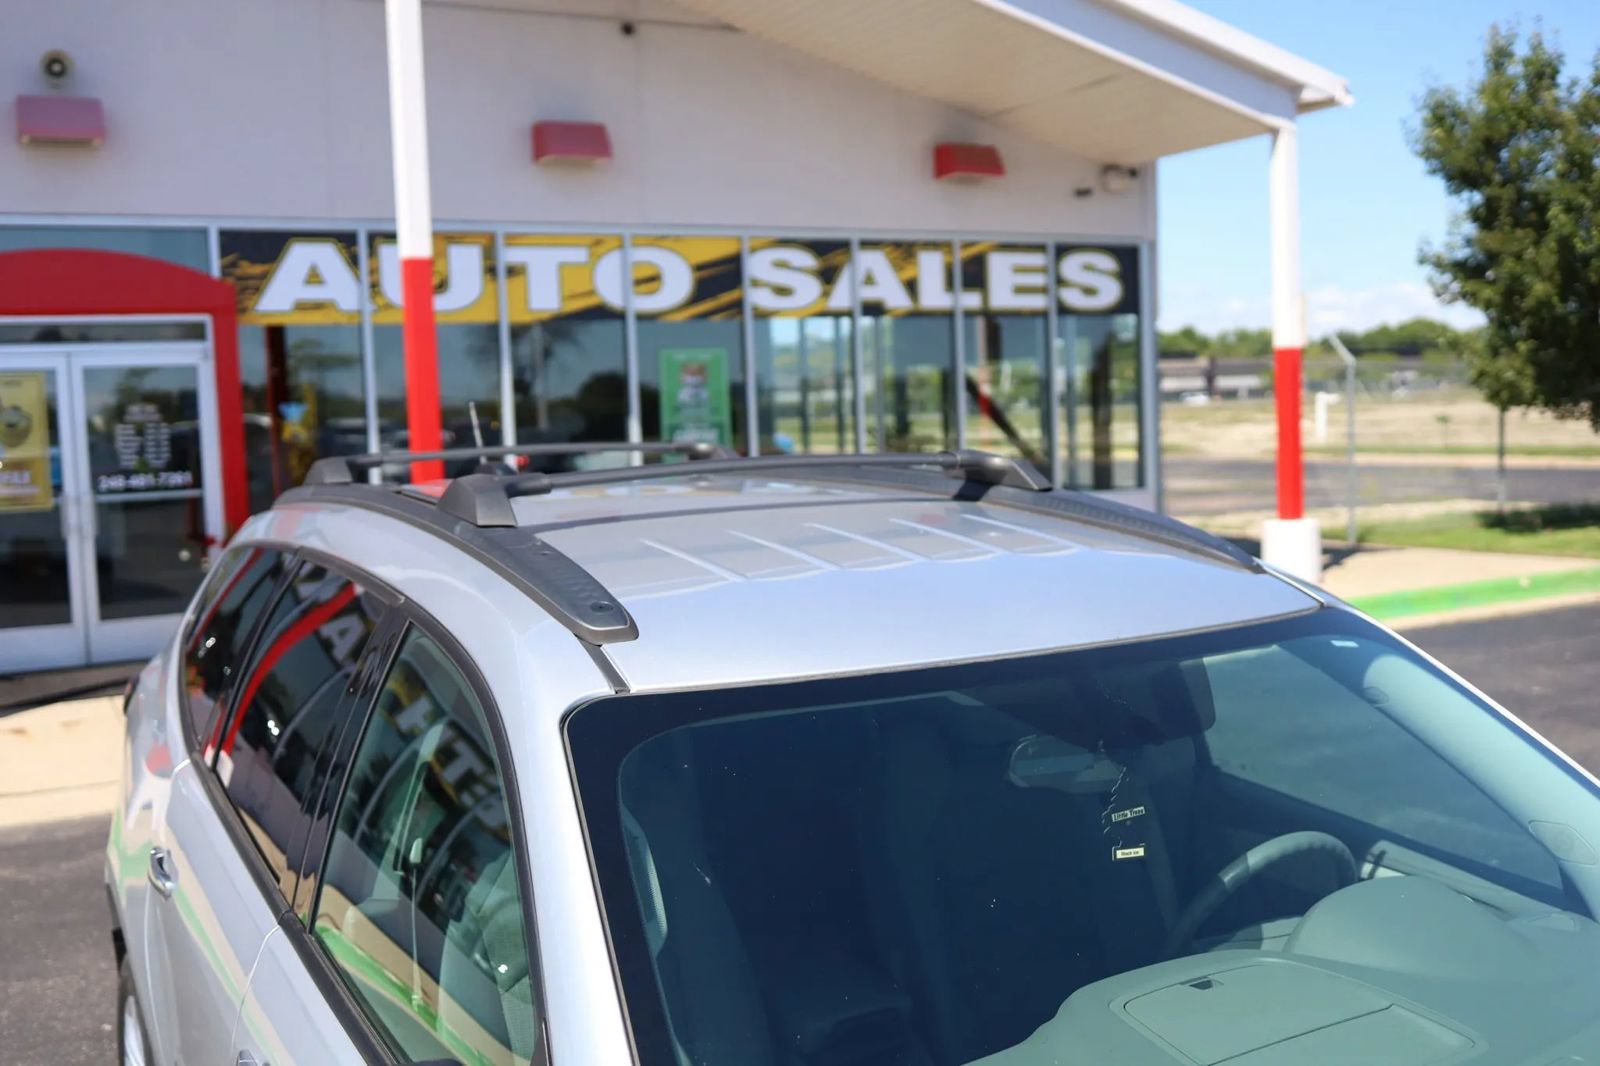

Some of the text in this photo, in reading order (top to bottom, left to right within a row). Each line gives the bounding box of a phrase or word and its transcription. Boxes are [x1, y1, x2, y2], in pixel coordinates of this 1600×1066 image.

[253, 241, 1123, 313] AUTO SALES
[1113, 807, 1145, 821] Little Trees
